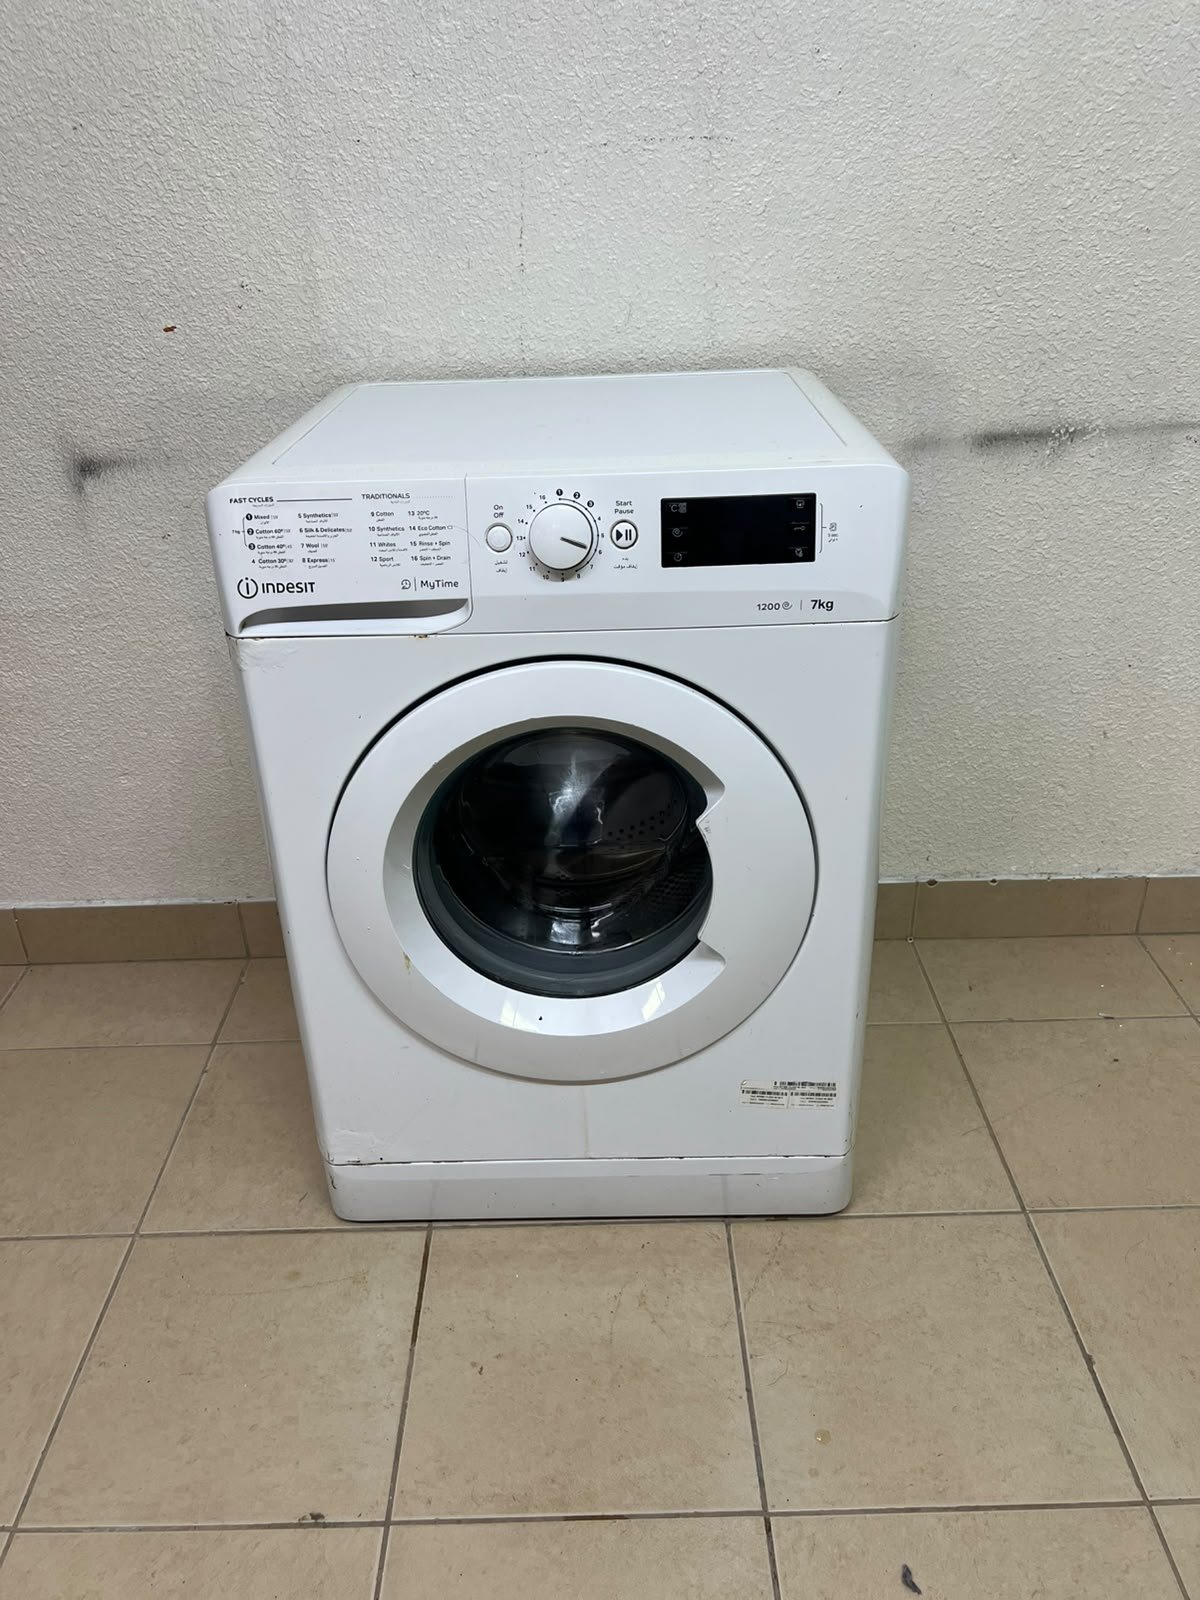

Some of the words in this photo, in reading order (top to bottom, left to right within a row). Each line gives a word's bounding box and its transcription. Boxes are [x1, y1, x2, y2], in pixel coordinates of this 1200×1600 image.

[261, 581, 316, 594] INDESIT
[420, 579, 459, 590] MyTime
[756, 602, 781, 611] 1200
[810, 599, 834, 612] 7kg
